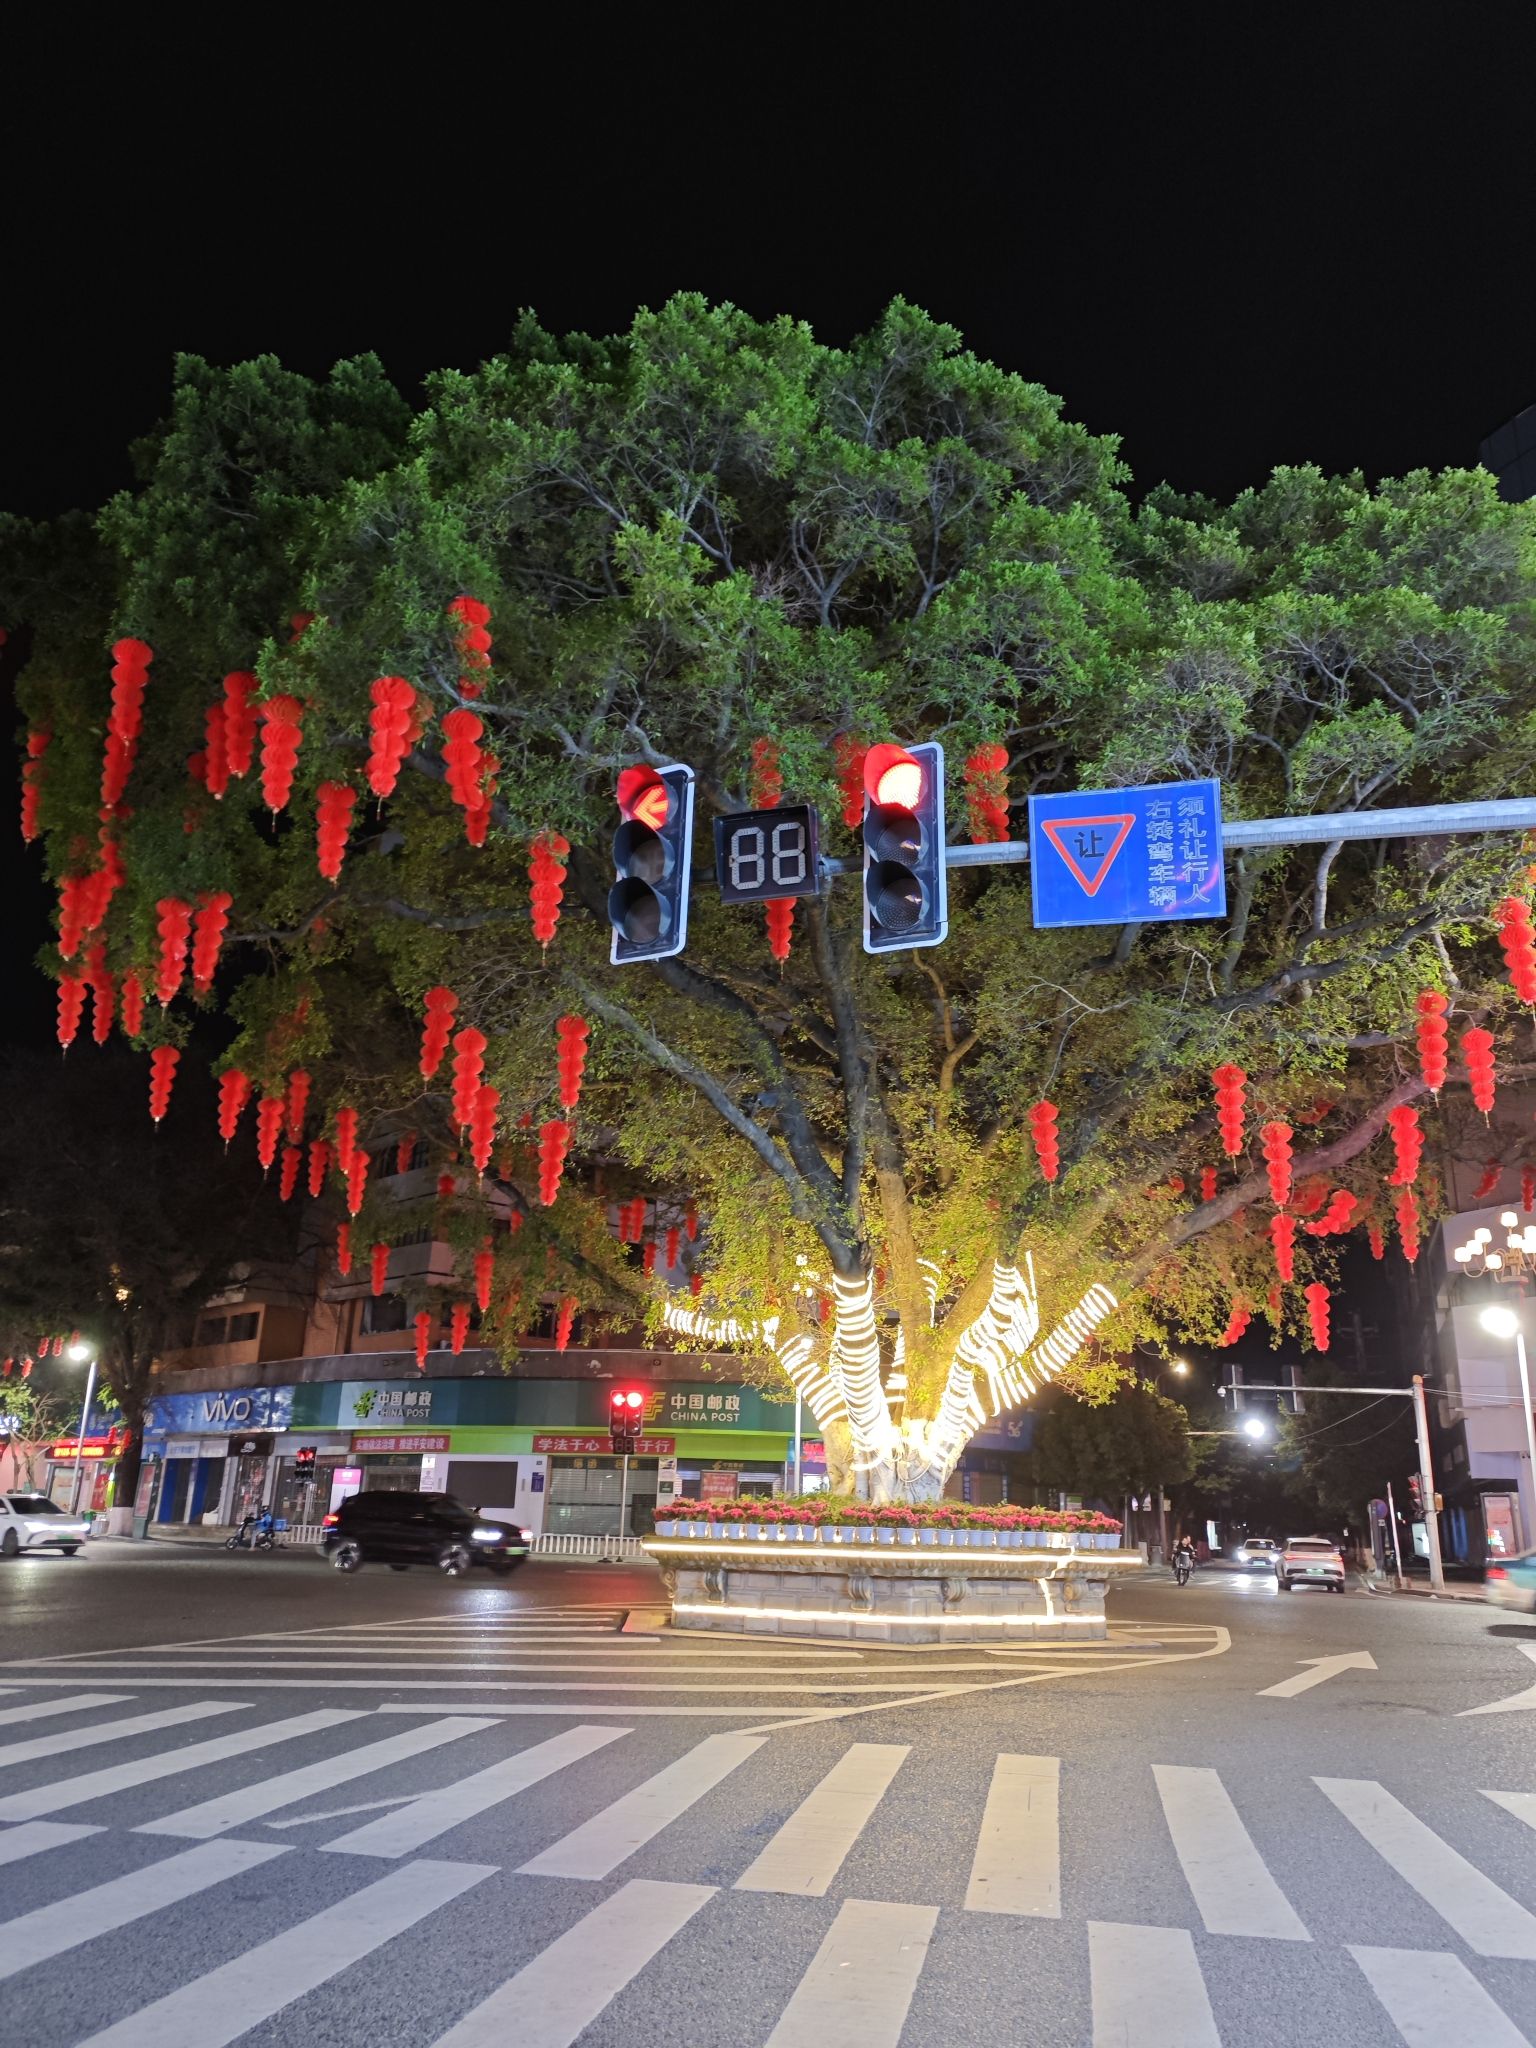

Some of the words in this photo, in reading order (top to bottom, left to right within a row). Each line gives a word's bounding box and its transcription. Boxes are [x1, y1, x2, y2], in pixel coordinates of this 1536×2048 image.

[1074, 830, 1105, 859] 让
[1145, 800, 1177, 907] 右转弯车辆
[1177, 796, 1211, 904] 须礼让行人
[203, 1392, 251, 1422] vivo
[378, 1391, 432, 1407] 中国邮政
[670, 1393, 740, 1411] 中国邮政
[378, 1409, 404, 1417] CHINA
[406, 1408, 431, 1417] POST
[670, 1411, 708, 1421] CHINA
[711, 1412, 740, 1422] POST
[538, 1438, 600, 1452] 学法于心
